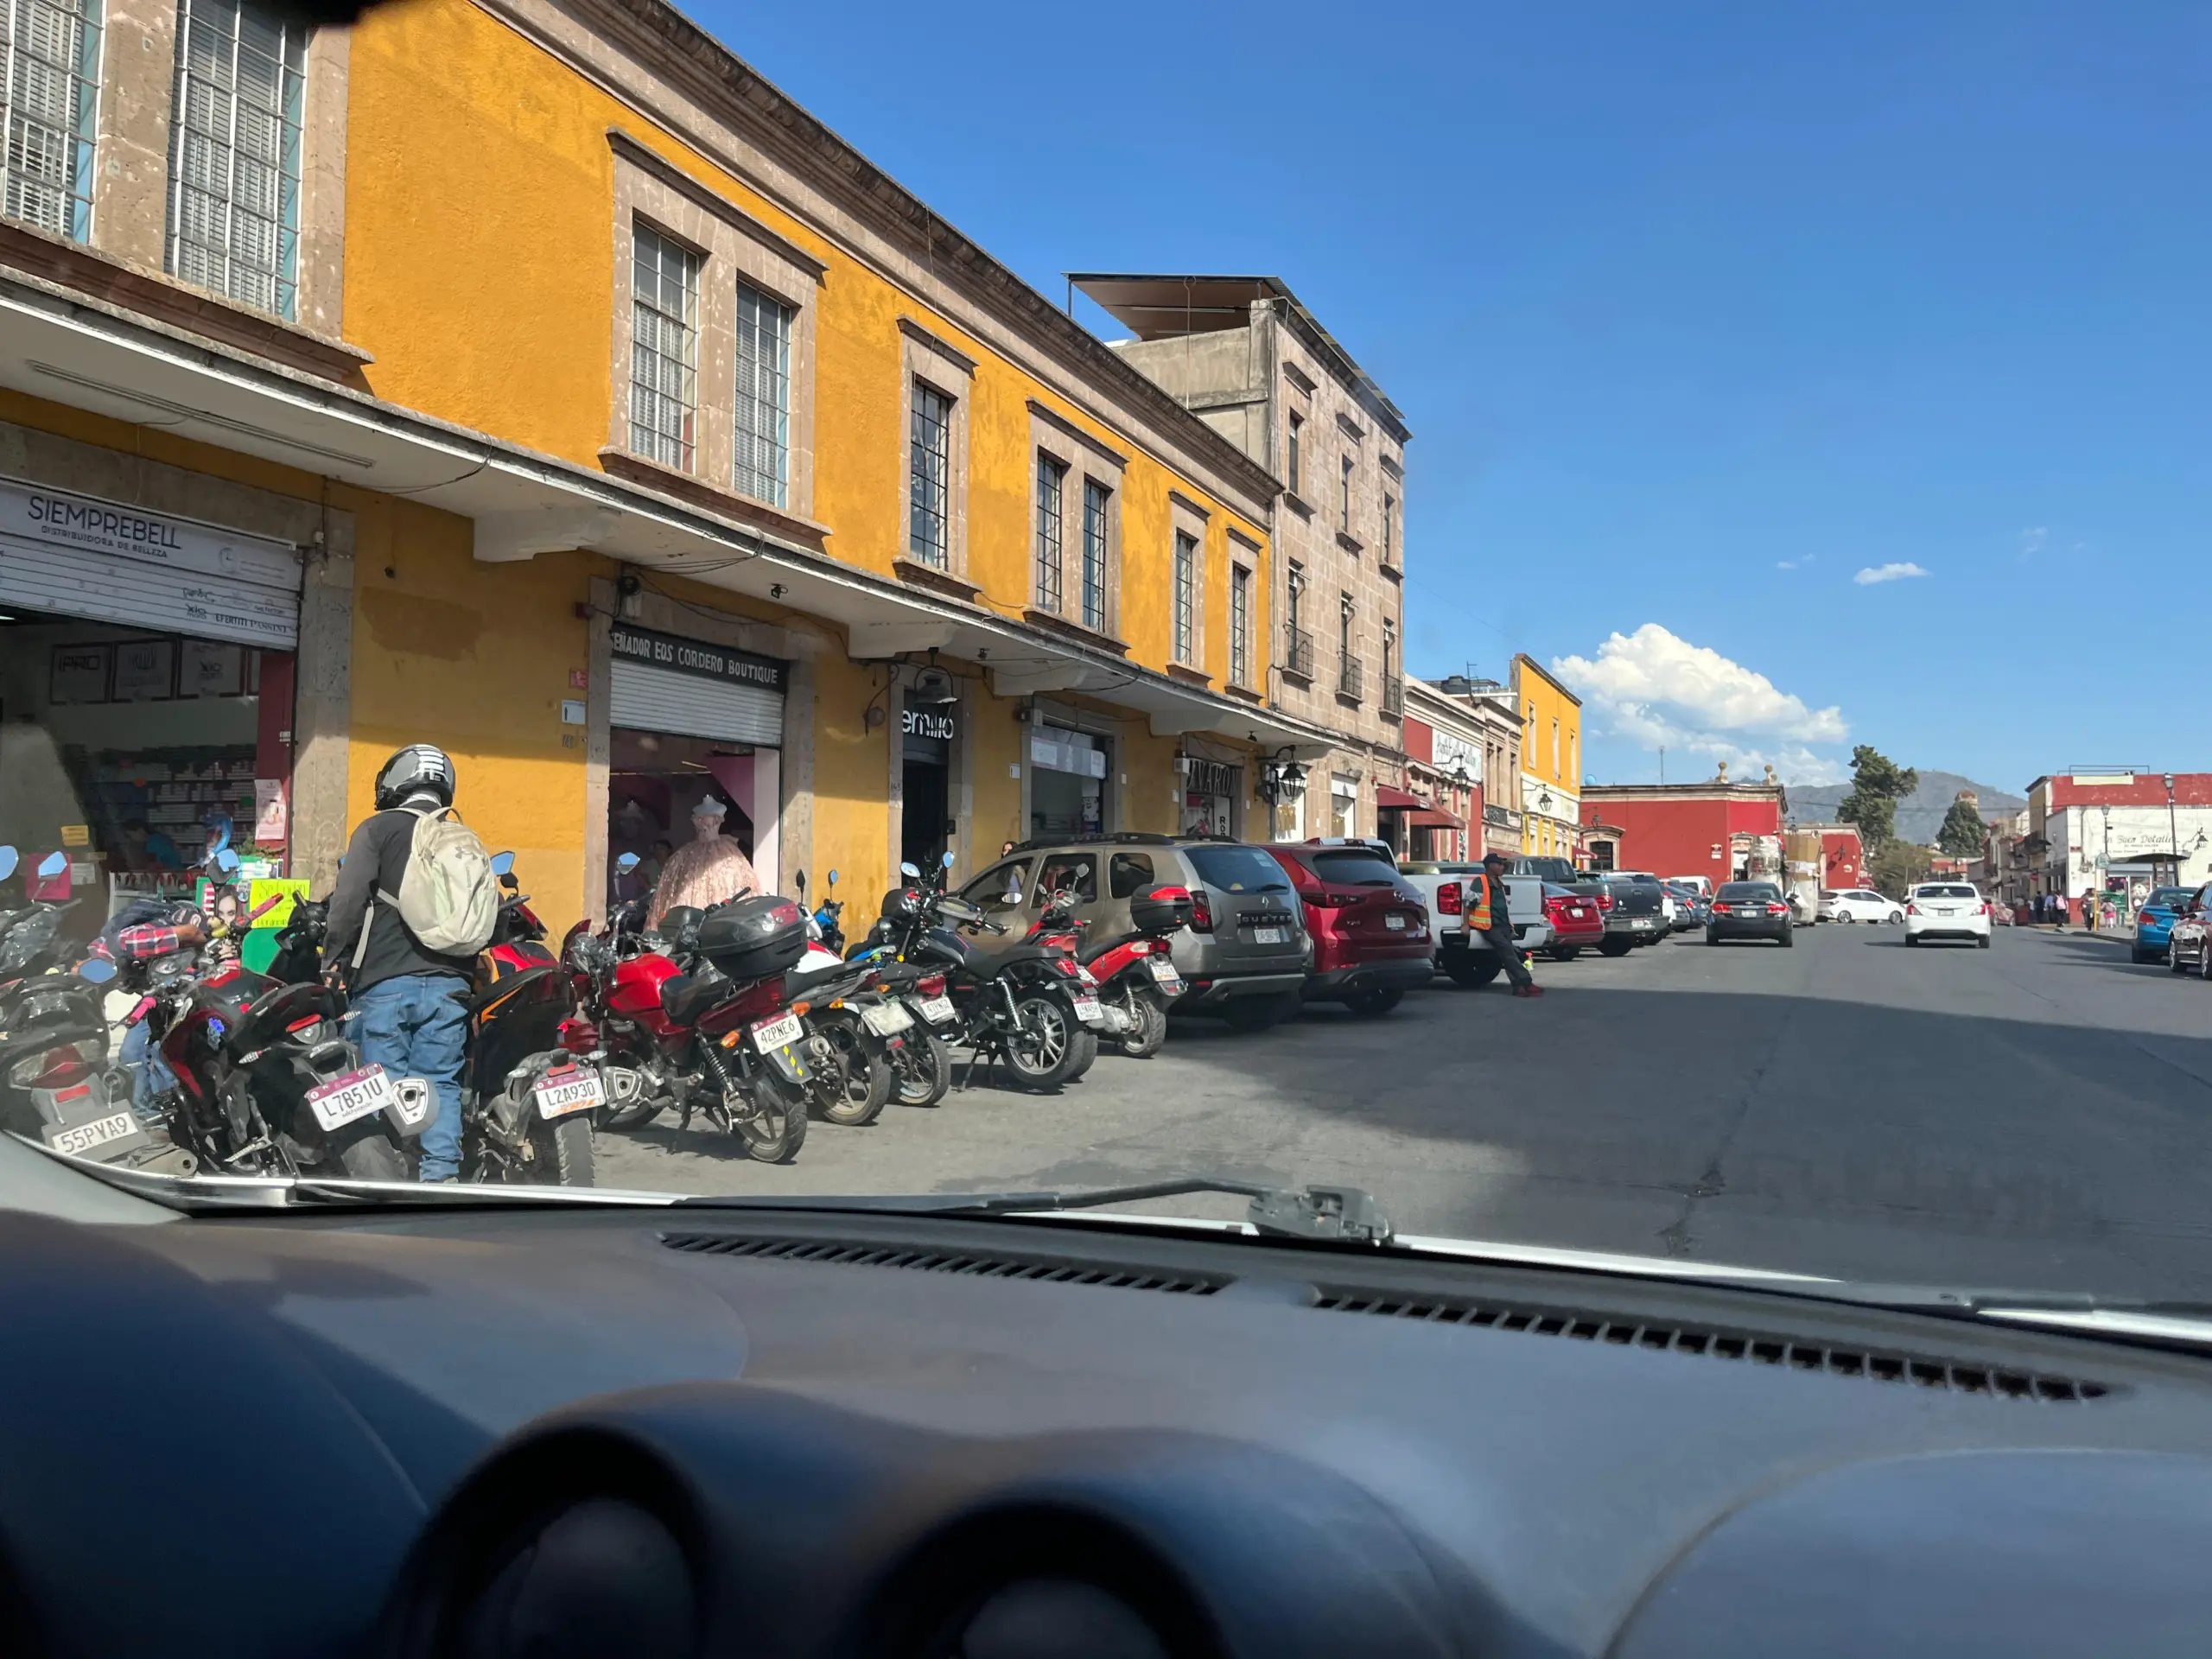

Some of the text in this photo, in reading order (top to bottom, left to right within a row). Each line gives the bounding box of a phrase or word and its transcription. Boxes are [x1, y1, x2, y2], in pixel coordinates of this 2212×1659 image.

[41, 525, 168, 557] DISTRIBUIDORA DE BELLEZA
[678, 647, 723, 673] CORDERO
[728, 659, 779, 683] BOUTIQUE
[761, 1020, 795, 1044] 42PNE6
[322, 1078, 383, 1116] L7B51U
[60, 1116, 127, 1153] 55PVA9
